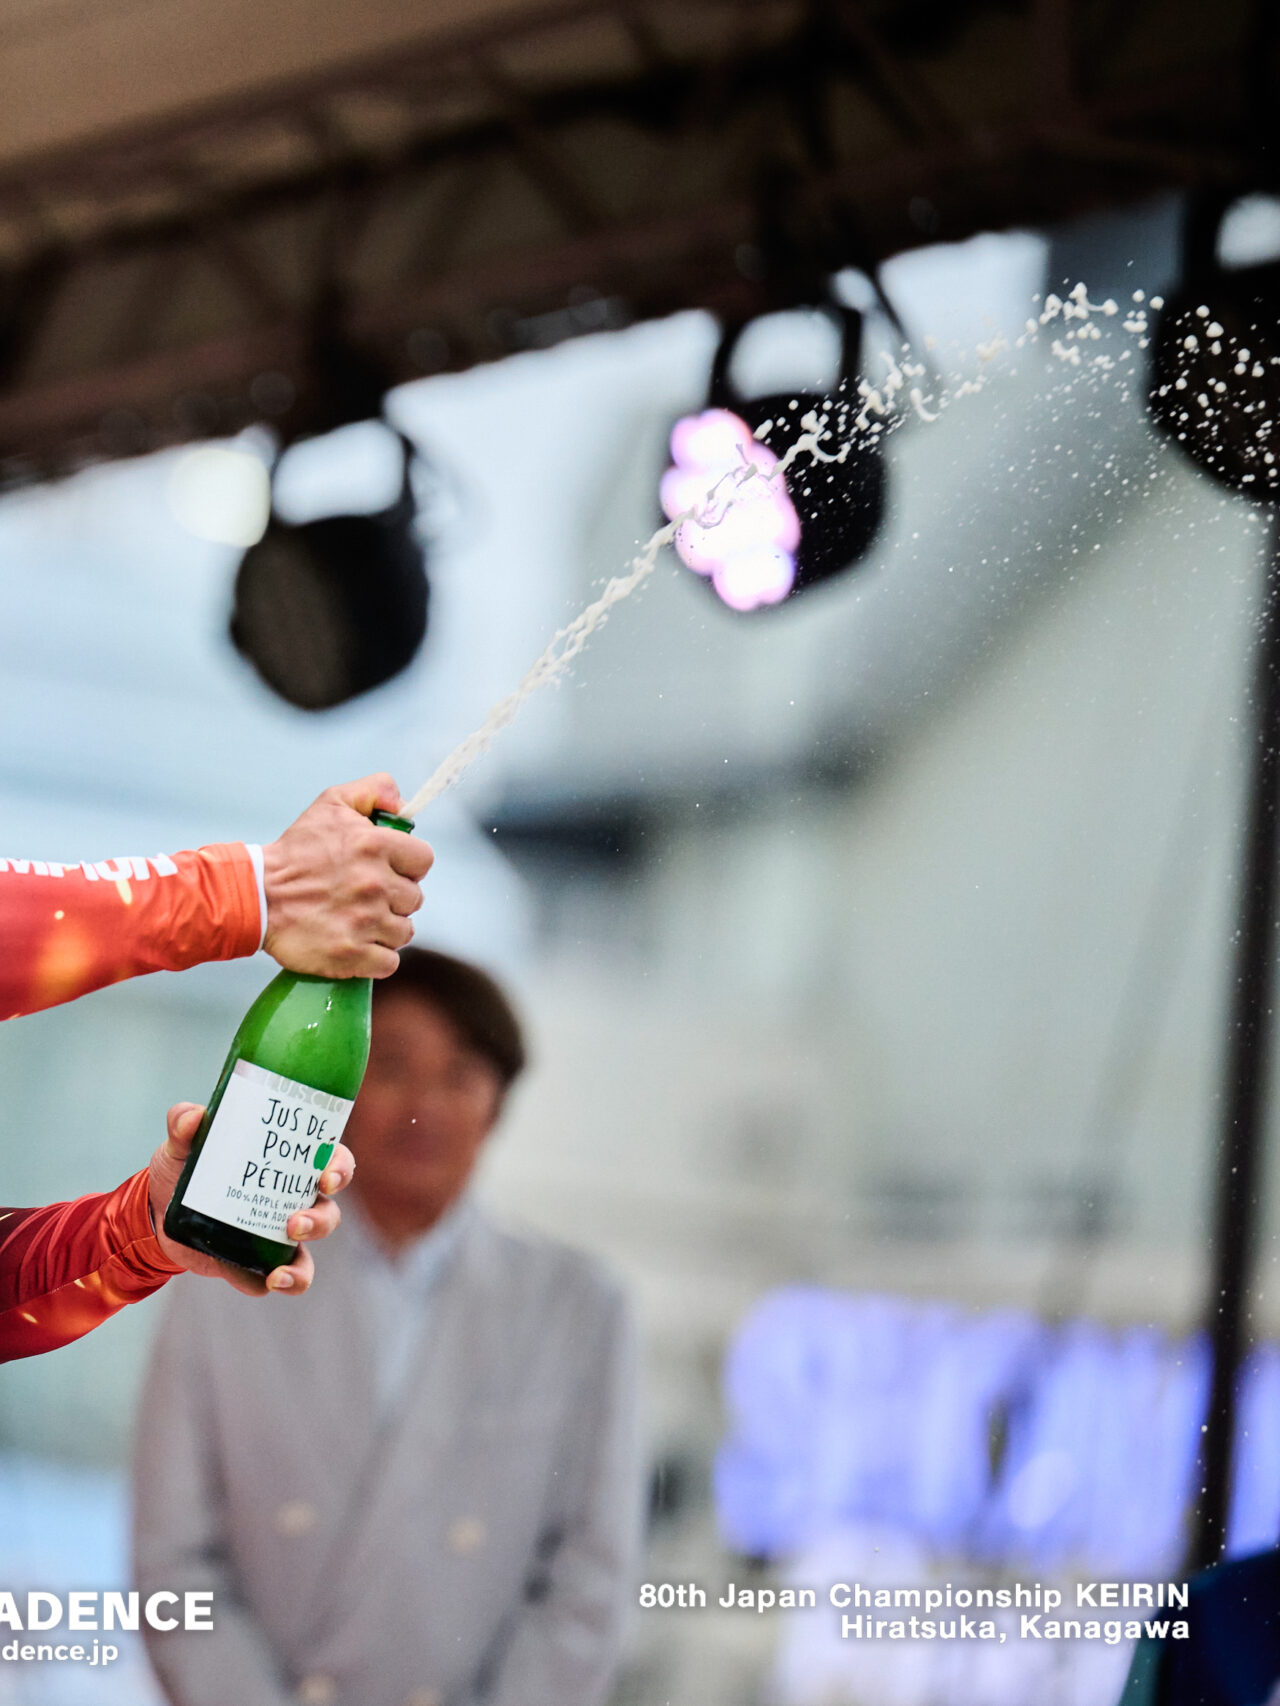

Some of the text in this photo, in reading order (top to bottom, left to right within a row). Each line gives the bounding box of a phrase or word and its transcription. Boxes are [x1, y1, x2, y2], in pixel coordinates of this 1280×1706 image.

[261, 1098, 328, 1140] JUS DE
[263, 1130, 311, 1164] POM
